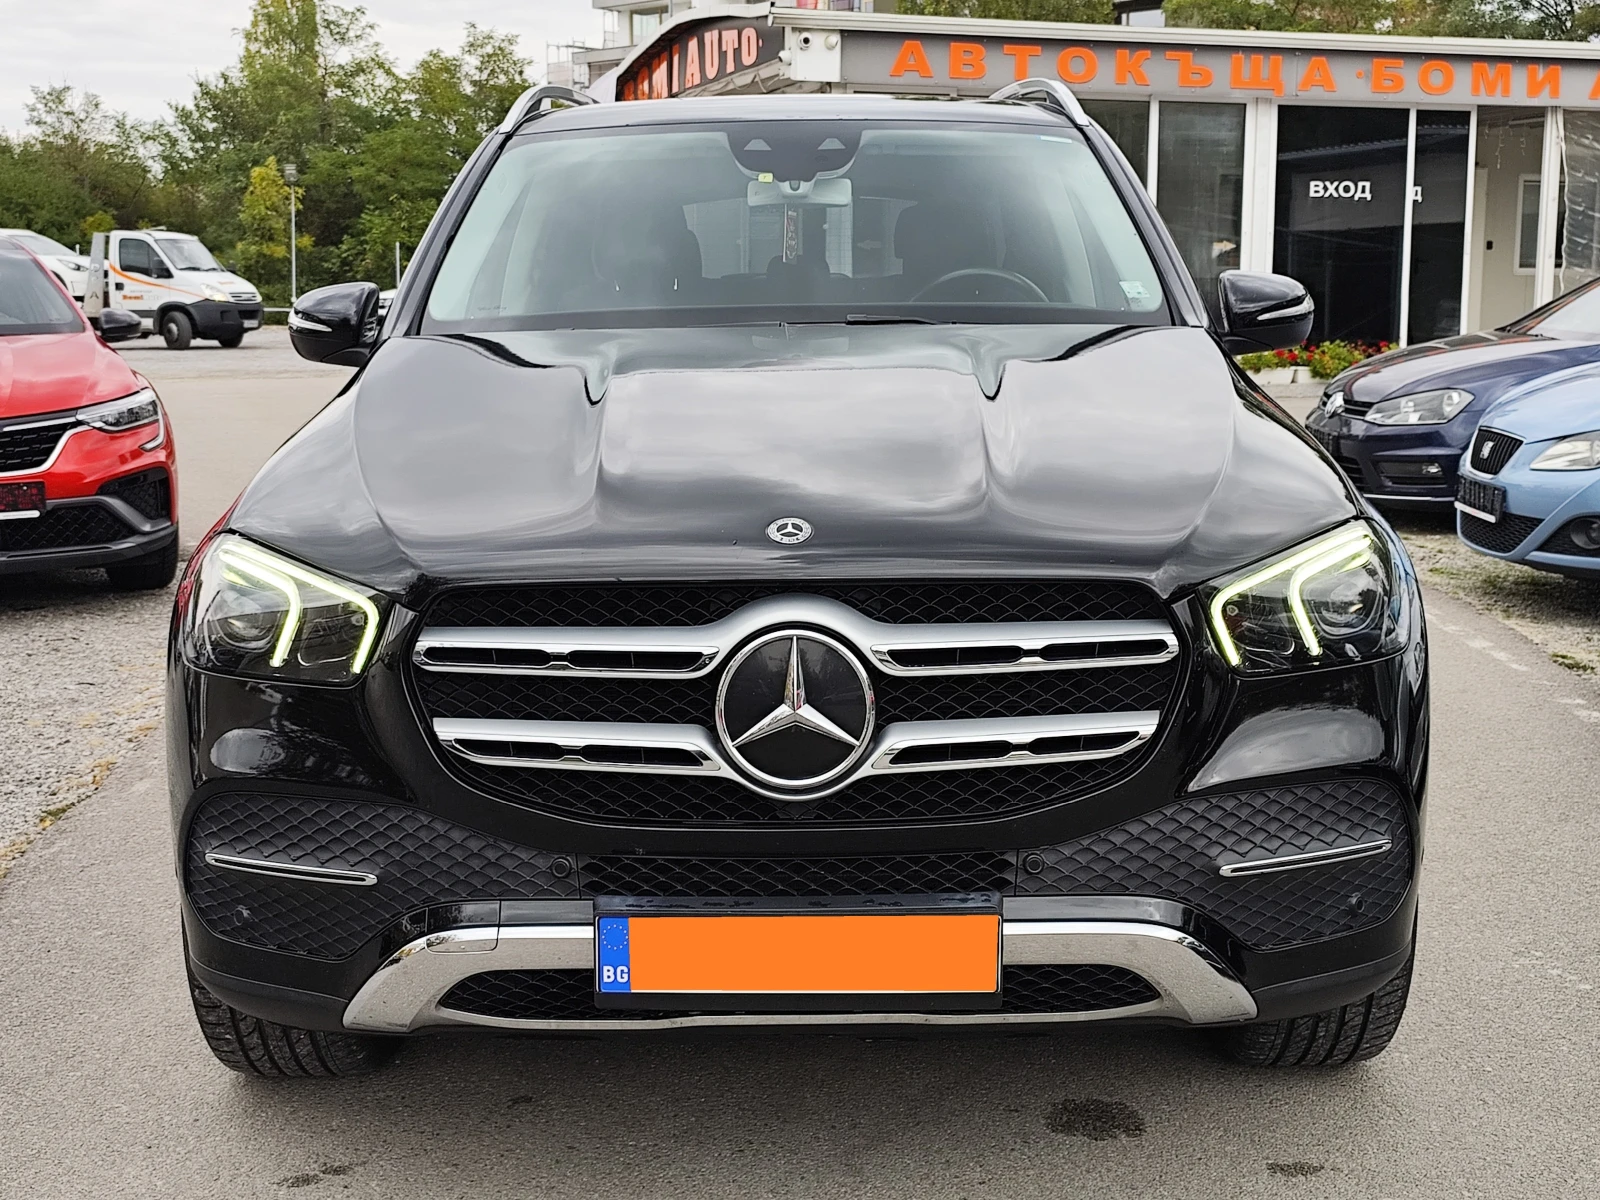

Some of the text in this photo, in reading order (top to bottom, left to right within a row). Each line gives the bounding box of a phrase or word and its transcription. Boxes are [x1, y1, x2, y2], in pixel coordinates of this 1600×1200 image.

[686, 27, 757, 88] AUTO
[889, 40, 1336, 96] АВТОКЪЩА
[1371, 58, 1561, 98] БОМИ
[1309, 181, 1372, 201] ВХОД
[603, 966, 629, 983] BG
